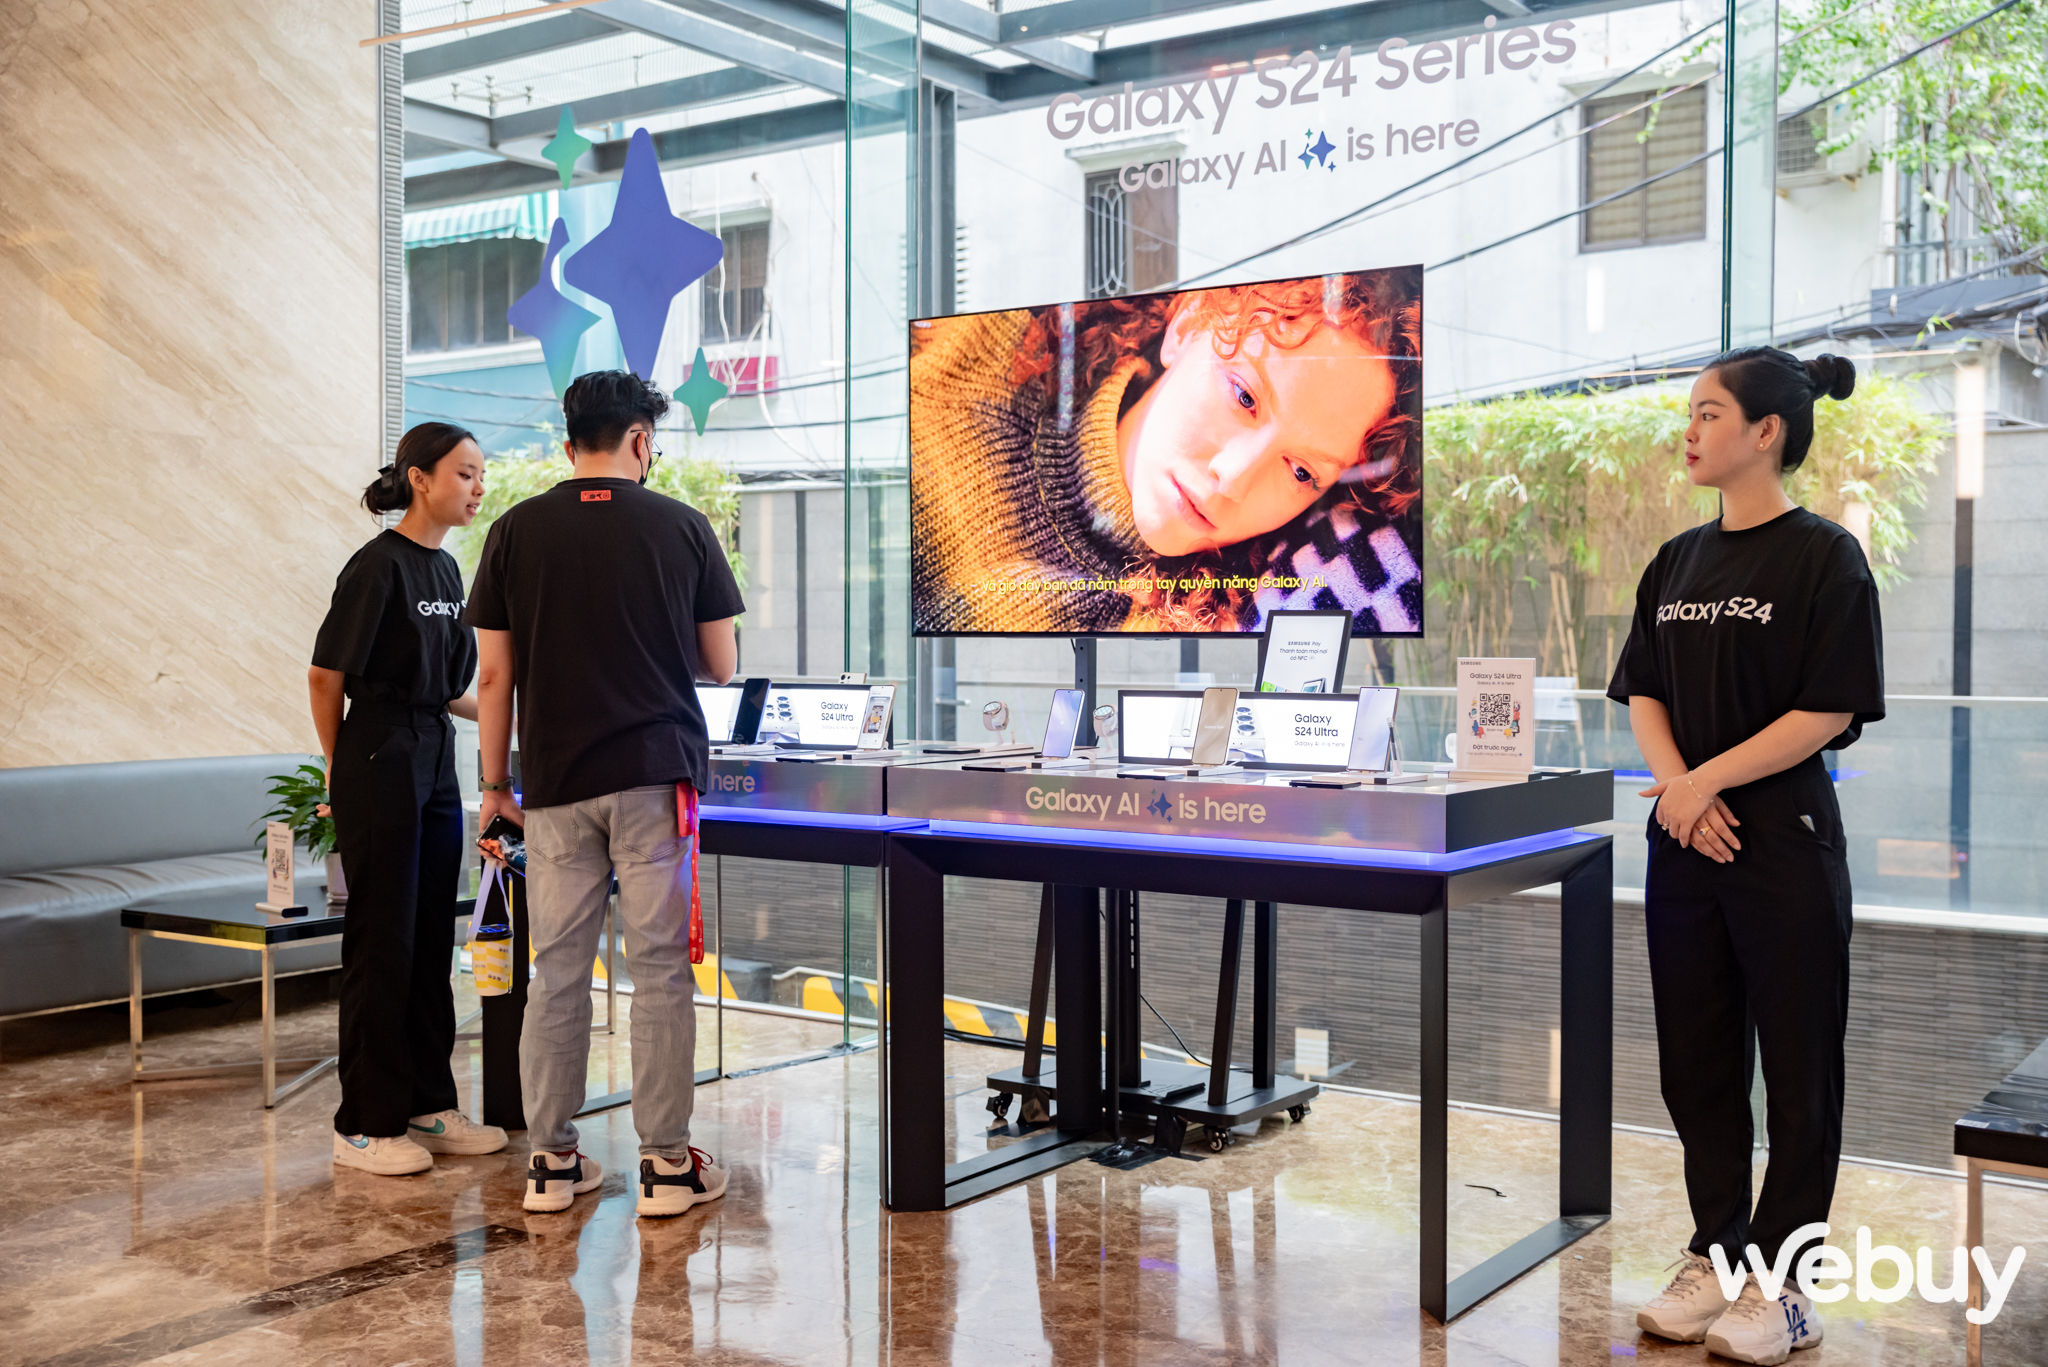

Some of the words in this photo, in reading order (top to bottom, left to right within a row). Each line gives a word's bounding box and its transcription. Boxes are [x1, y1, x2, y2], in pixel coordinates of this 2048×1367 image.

[1046, 72, 1240, 140] Galaxy
[1255, 44, 1357, 109] S24
[1374, 15, 1577, 90] Series
[1118, 151, 1244, 193] Galaxy
[1253, 140, 1287, 176] AI
[1347, 127, 1375, 163] is
[1385, 118, 1480, 157] here
[1069, 577, 1086, 591] đã
[1119, 577, 1154, 593] trong
[1156, 577, 1177, 593] tay
[1179, 573, 1221, 593] quyền
[1223, 575, 1258, 593] năng
[1261, 575, 1309, 592] Galaxy
[1723, 596, 1773, 625] S24
[1469, 672, 1492, 680] Galaxy
[821, 701, 848, 712] Galaxy
[821, 713, 834, 721] S24
[835, 713, 854, 721] Ultra
[1294, 713, 1332, 726] Galaxy
[1294, 726, 1312, 736] S24
[1314, 726, 1338, 737] Ultra
[710, 771, 756, 793] here
[1025, 786, 1112, 821] Galaxy
[1116, 792, 1139, 816] AI
[1178, 793, 1198, 819] is
[1204, 796, 1266, 823] here
